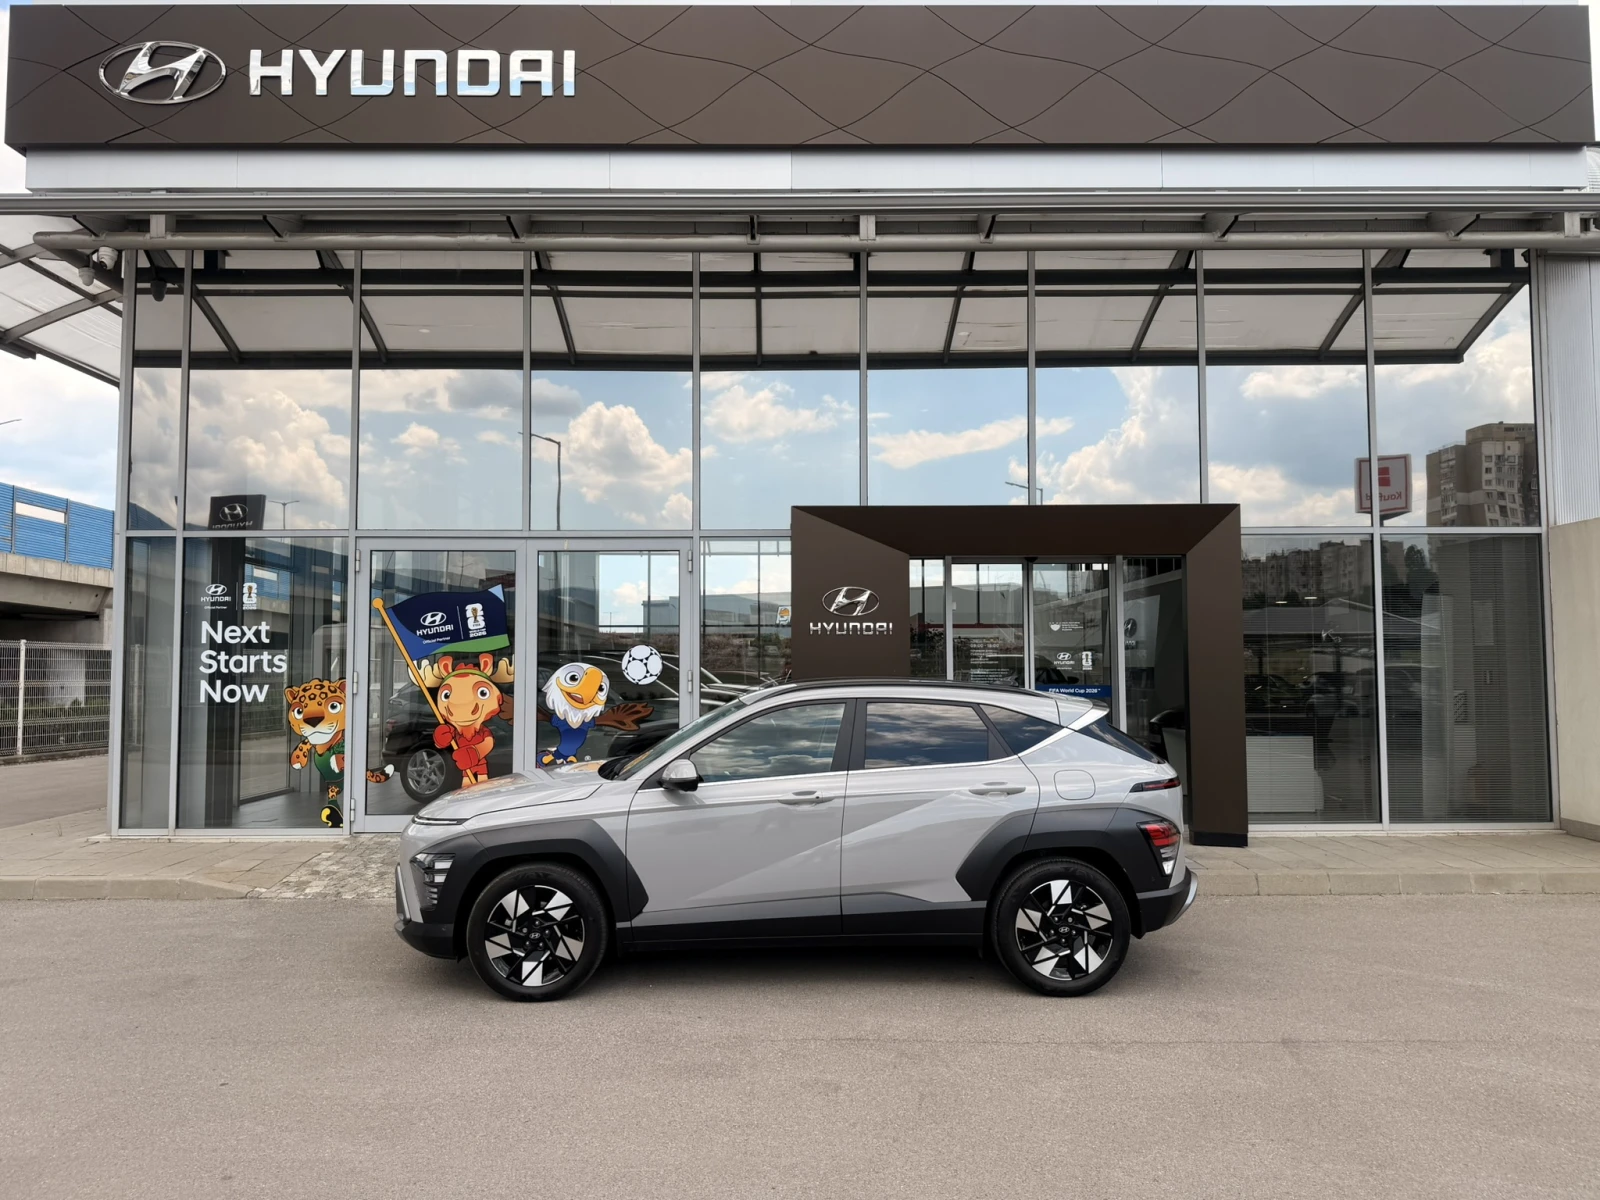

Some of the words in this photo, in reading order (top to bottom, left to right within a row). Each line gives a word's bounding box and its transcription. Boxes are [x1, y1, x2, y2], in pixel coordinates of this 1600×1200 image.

[248, 48, 577, 97] HYUNDAI
[201, 620, 271, 644] Next
[416, 624, 454, 636] HYUNDAI
[809, 622, 893, 635] HYUNDAI
[199, 649, 288, 674] Starts
[199, 679, 270, 703] Now
